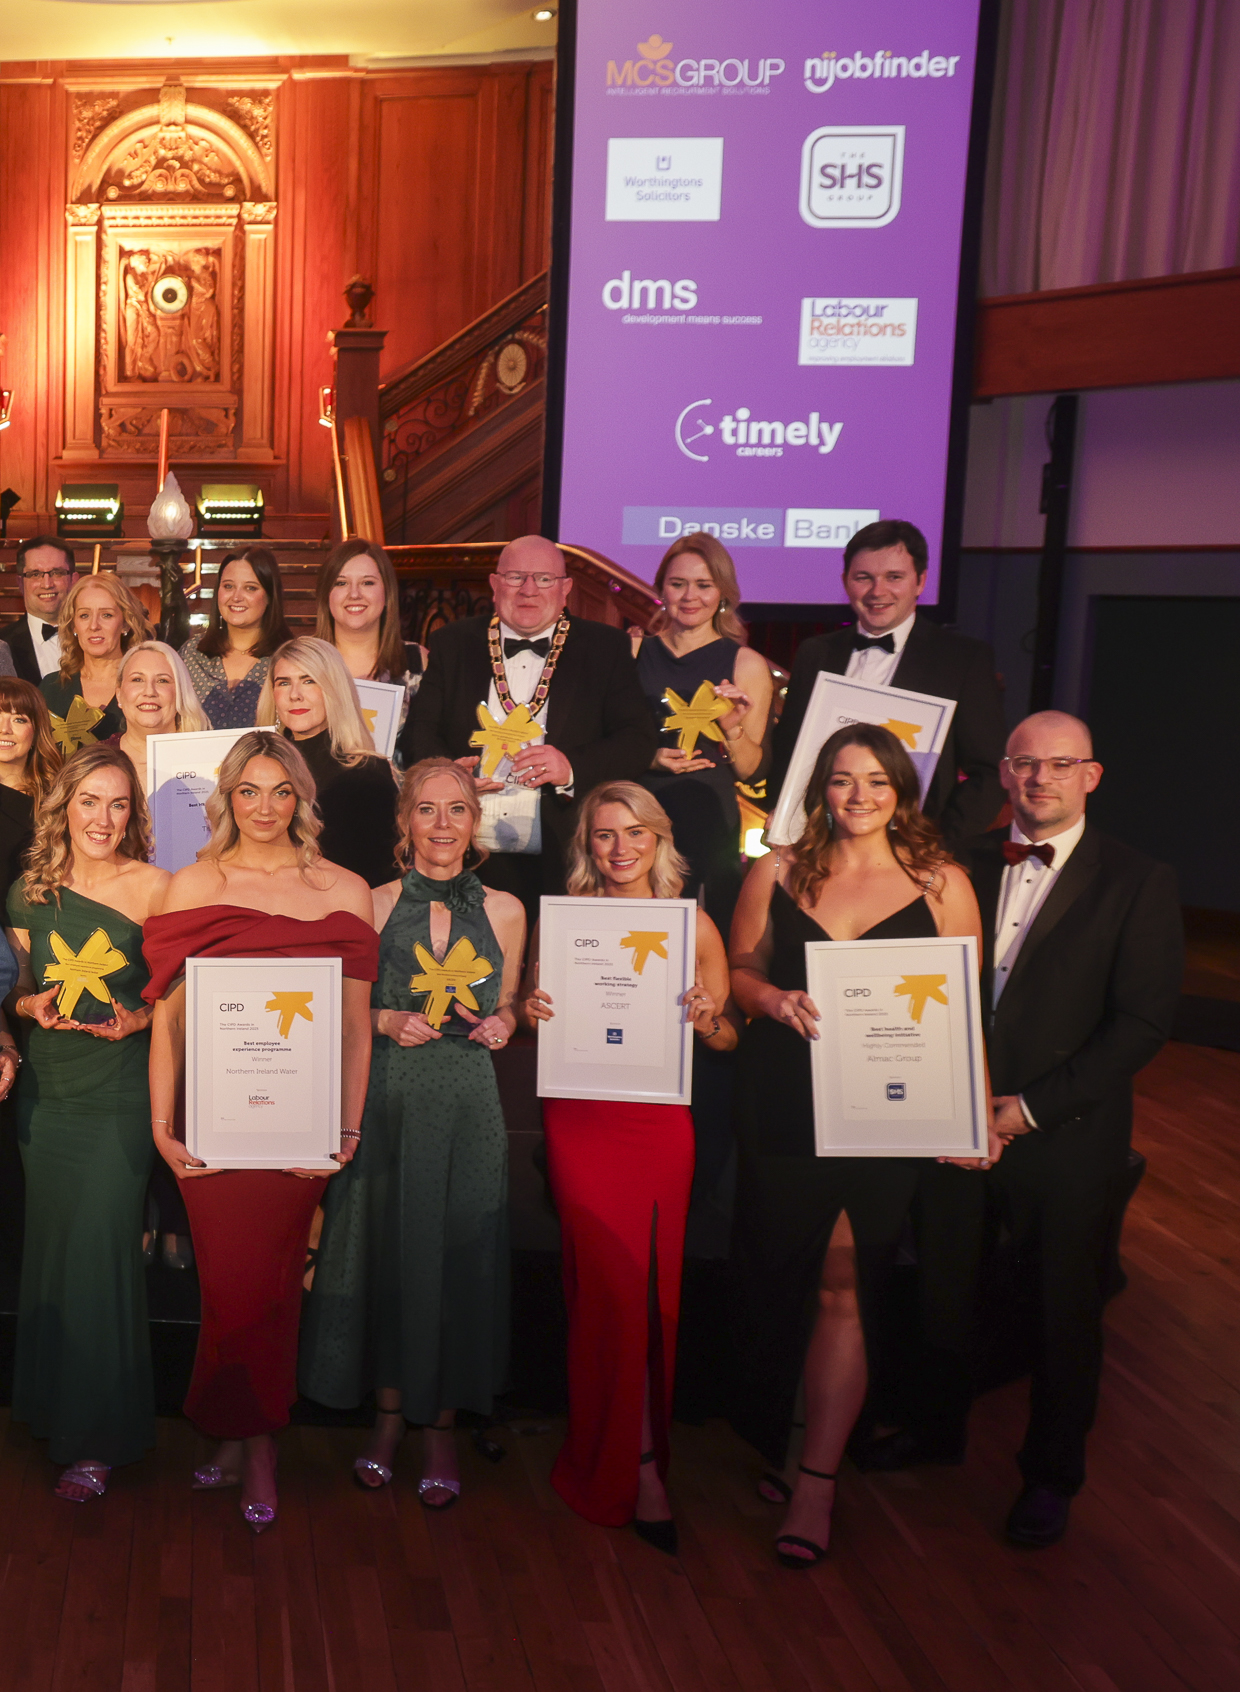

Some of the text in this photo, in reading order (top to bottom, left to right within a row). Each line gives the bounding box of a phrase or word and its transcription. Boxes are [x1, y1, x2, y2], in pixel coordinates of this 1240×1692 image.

[804, 50, 960, 94] nijobfinder
[607, 86, 771, 96] INTELLIGENT RECRUITMENT SOLUTIONS
[624, 176, 703, 189] Worthingtons
[819, 163, 885, 189] SHS
[636, 189, 691, 202] Solicitors
[602, 270, 698, 310] dms
[811, 299, 889, 318] Labour
[622, 313, 763, 325] development means success
[810, 317, 907, 337] Relations
[809, 337, 861, 352] agency
[719, 407, 844, 454] timely
[736, 445, 784, 457] careers
[658, 516, 776, 540] Danske
[175, 770, 197, 780] CIPD
[574, 938, 600, 948] CIPD
[844, 988, 872, 998] CIPD
[219, 1002, 245, 1012] CIPD
[601, 1002, 631, 1010] ASCERT
[895, 1054, 922, 1063] Group
